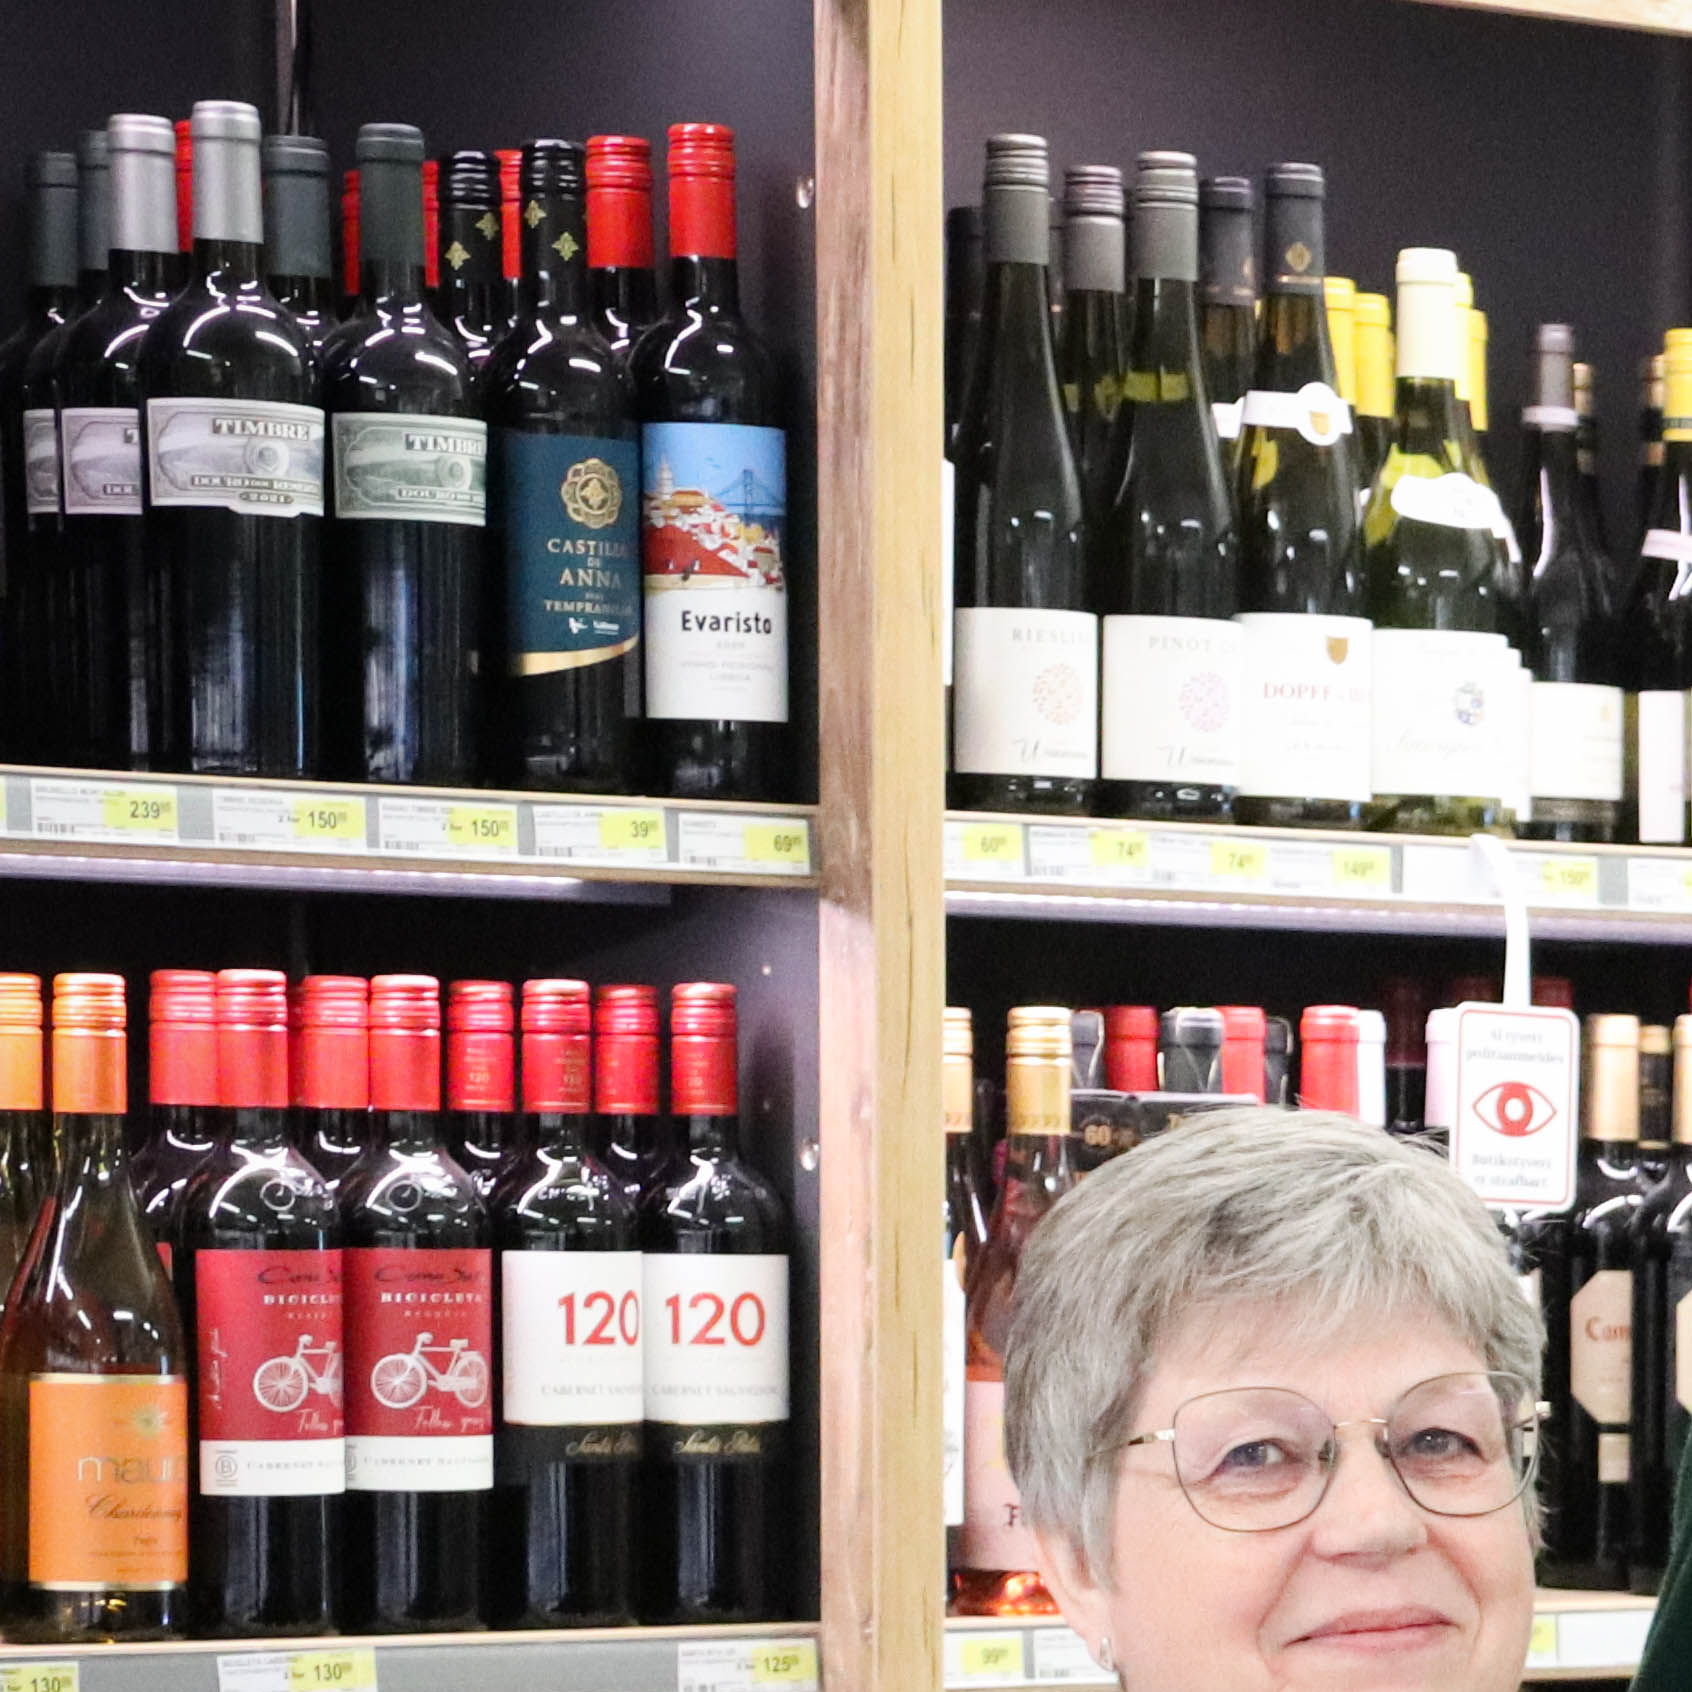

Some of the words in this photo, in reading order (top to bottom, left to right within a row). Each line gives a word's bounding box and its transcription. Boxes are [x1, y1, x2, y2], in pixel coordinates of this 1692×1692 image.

[214, 417, 312, 441] TIMBRE
[559, 567, 621, 590] ANNA
[680, 610, 773, 636] Evaristo
[557, 1289, 640, 1347] 120
[664, 1291, 767, 1347] 120
